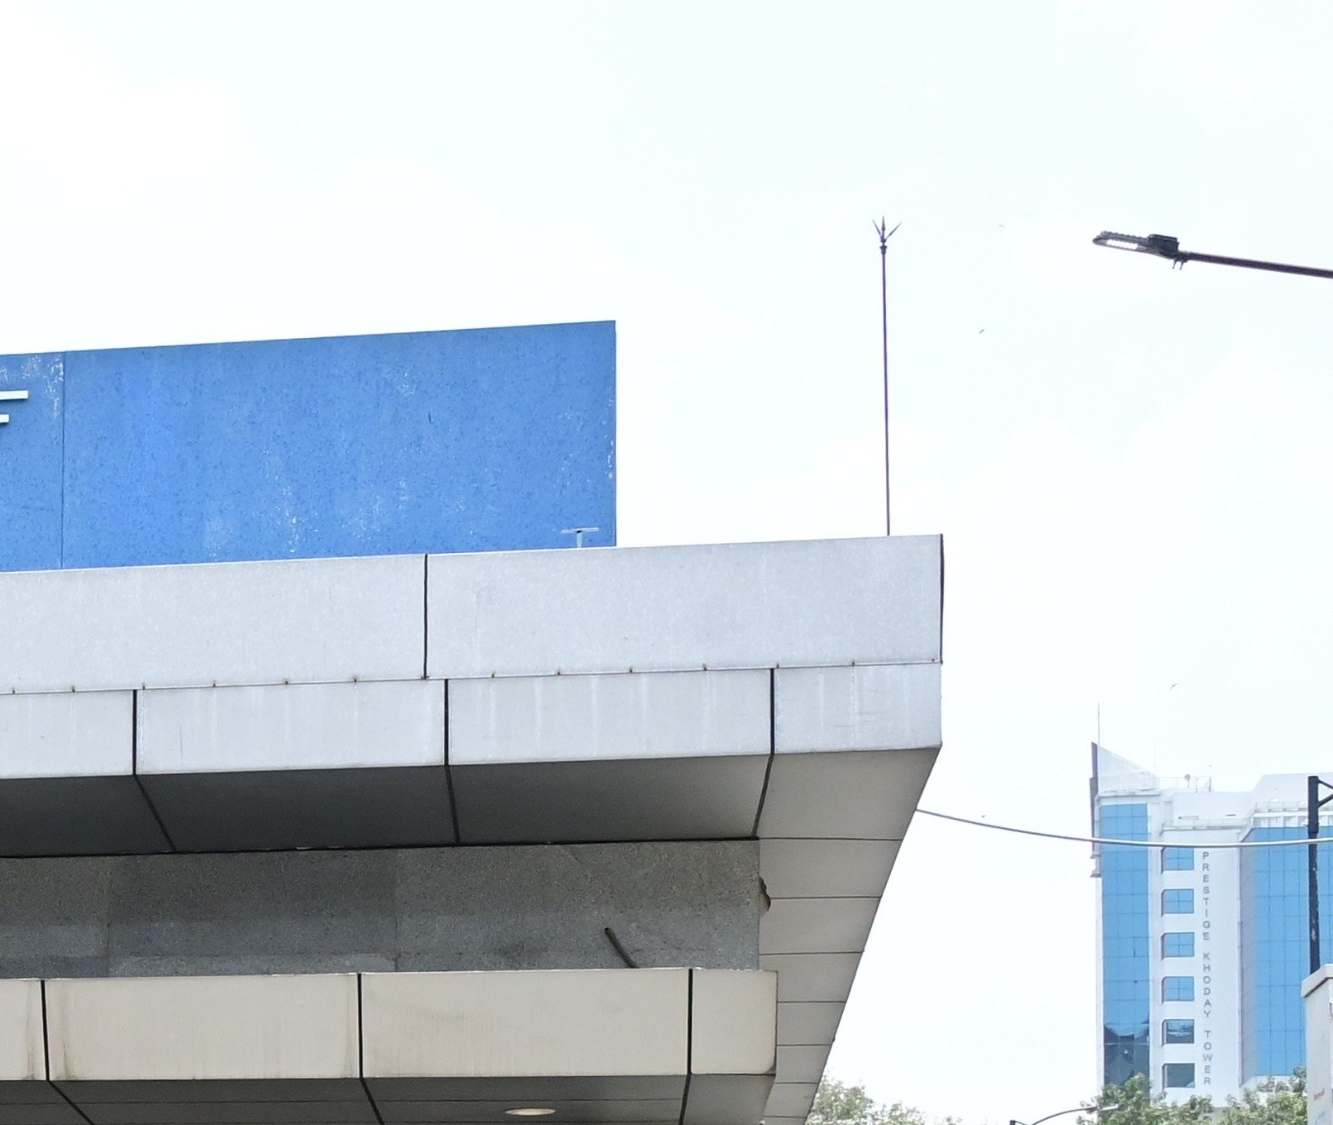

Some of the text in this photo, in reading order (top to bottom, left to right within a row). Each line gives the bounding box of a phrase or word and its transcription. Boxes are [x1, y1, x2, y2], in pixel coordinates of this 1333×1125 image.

[1202, 851, 1212, 1086] PRESTIGE KHODAY TOWER
